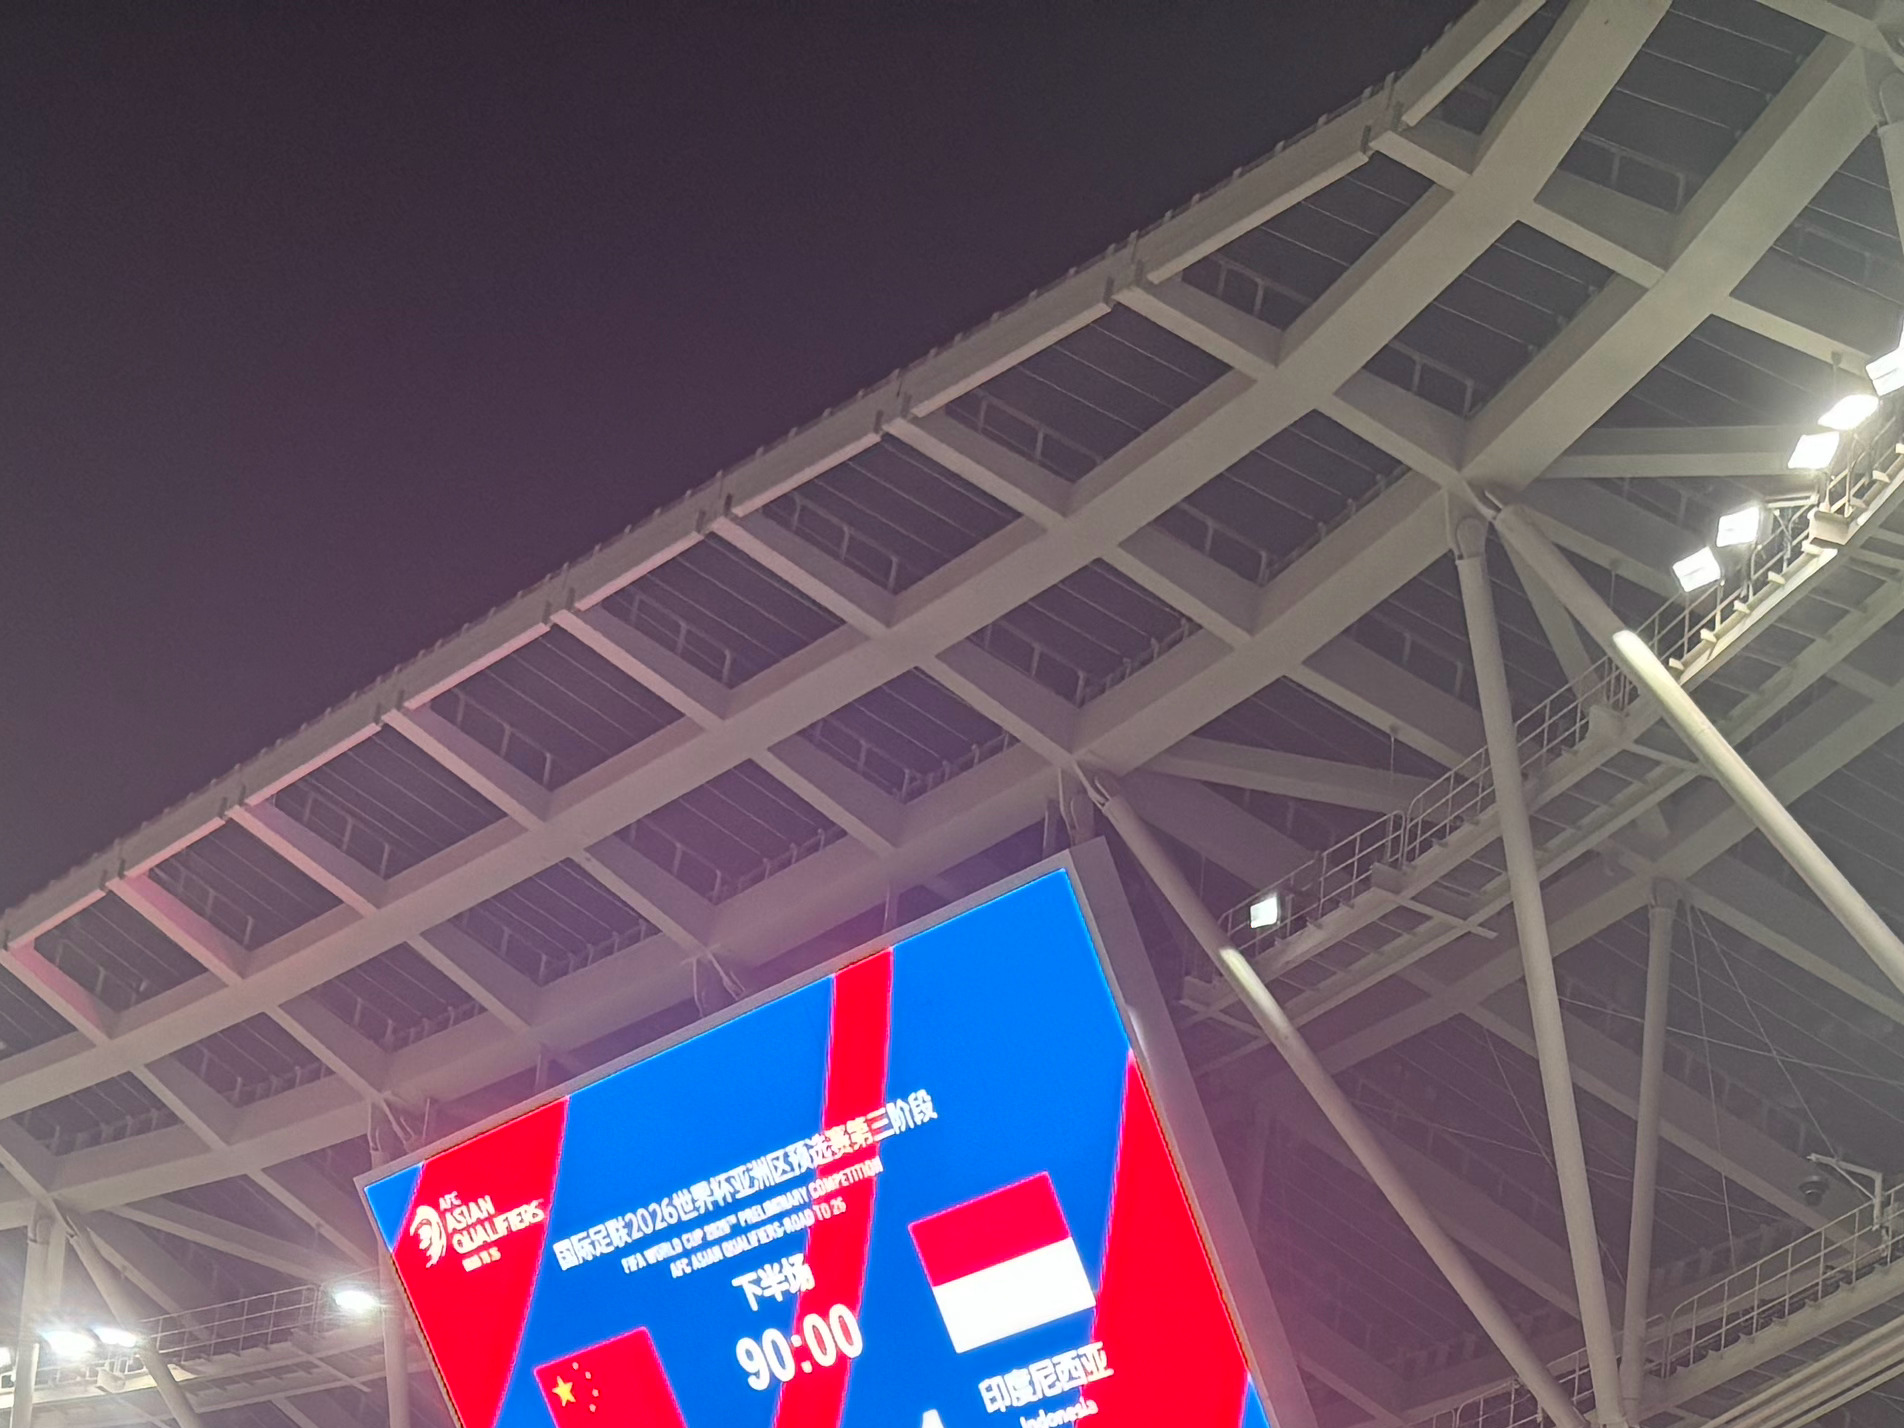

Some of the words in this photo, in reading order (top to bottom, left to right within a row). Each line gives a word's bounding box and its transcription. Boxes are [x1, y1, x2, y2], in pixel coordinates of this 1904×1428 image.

[553, 1089, 938, 1271] 国际足联2026世界杯亚洲区预选赛第三阶段
[809, 1156, 884, 1199] COMPETITION
[445, 1195, 496, 1234] ASIAN
[452, 1200, 545, 1254] QUALIFIERS
[732, 1254, 816, 1311] 下半场
[736, 1303, 863, 1390] 90:00
[977, 1341, 1114, 1414] 印度尼西亚
